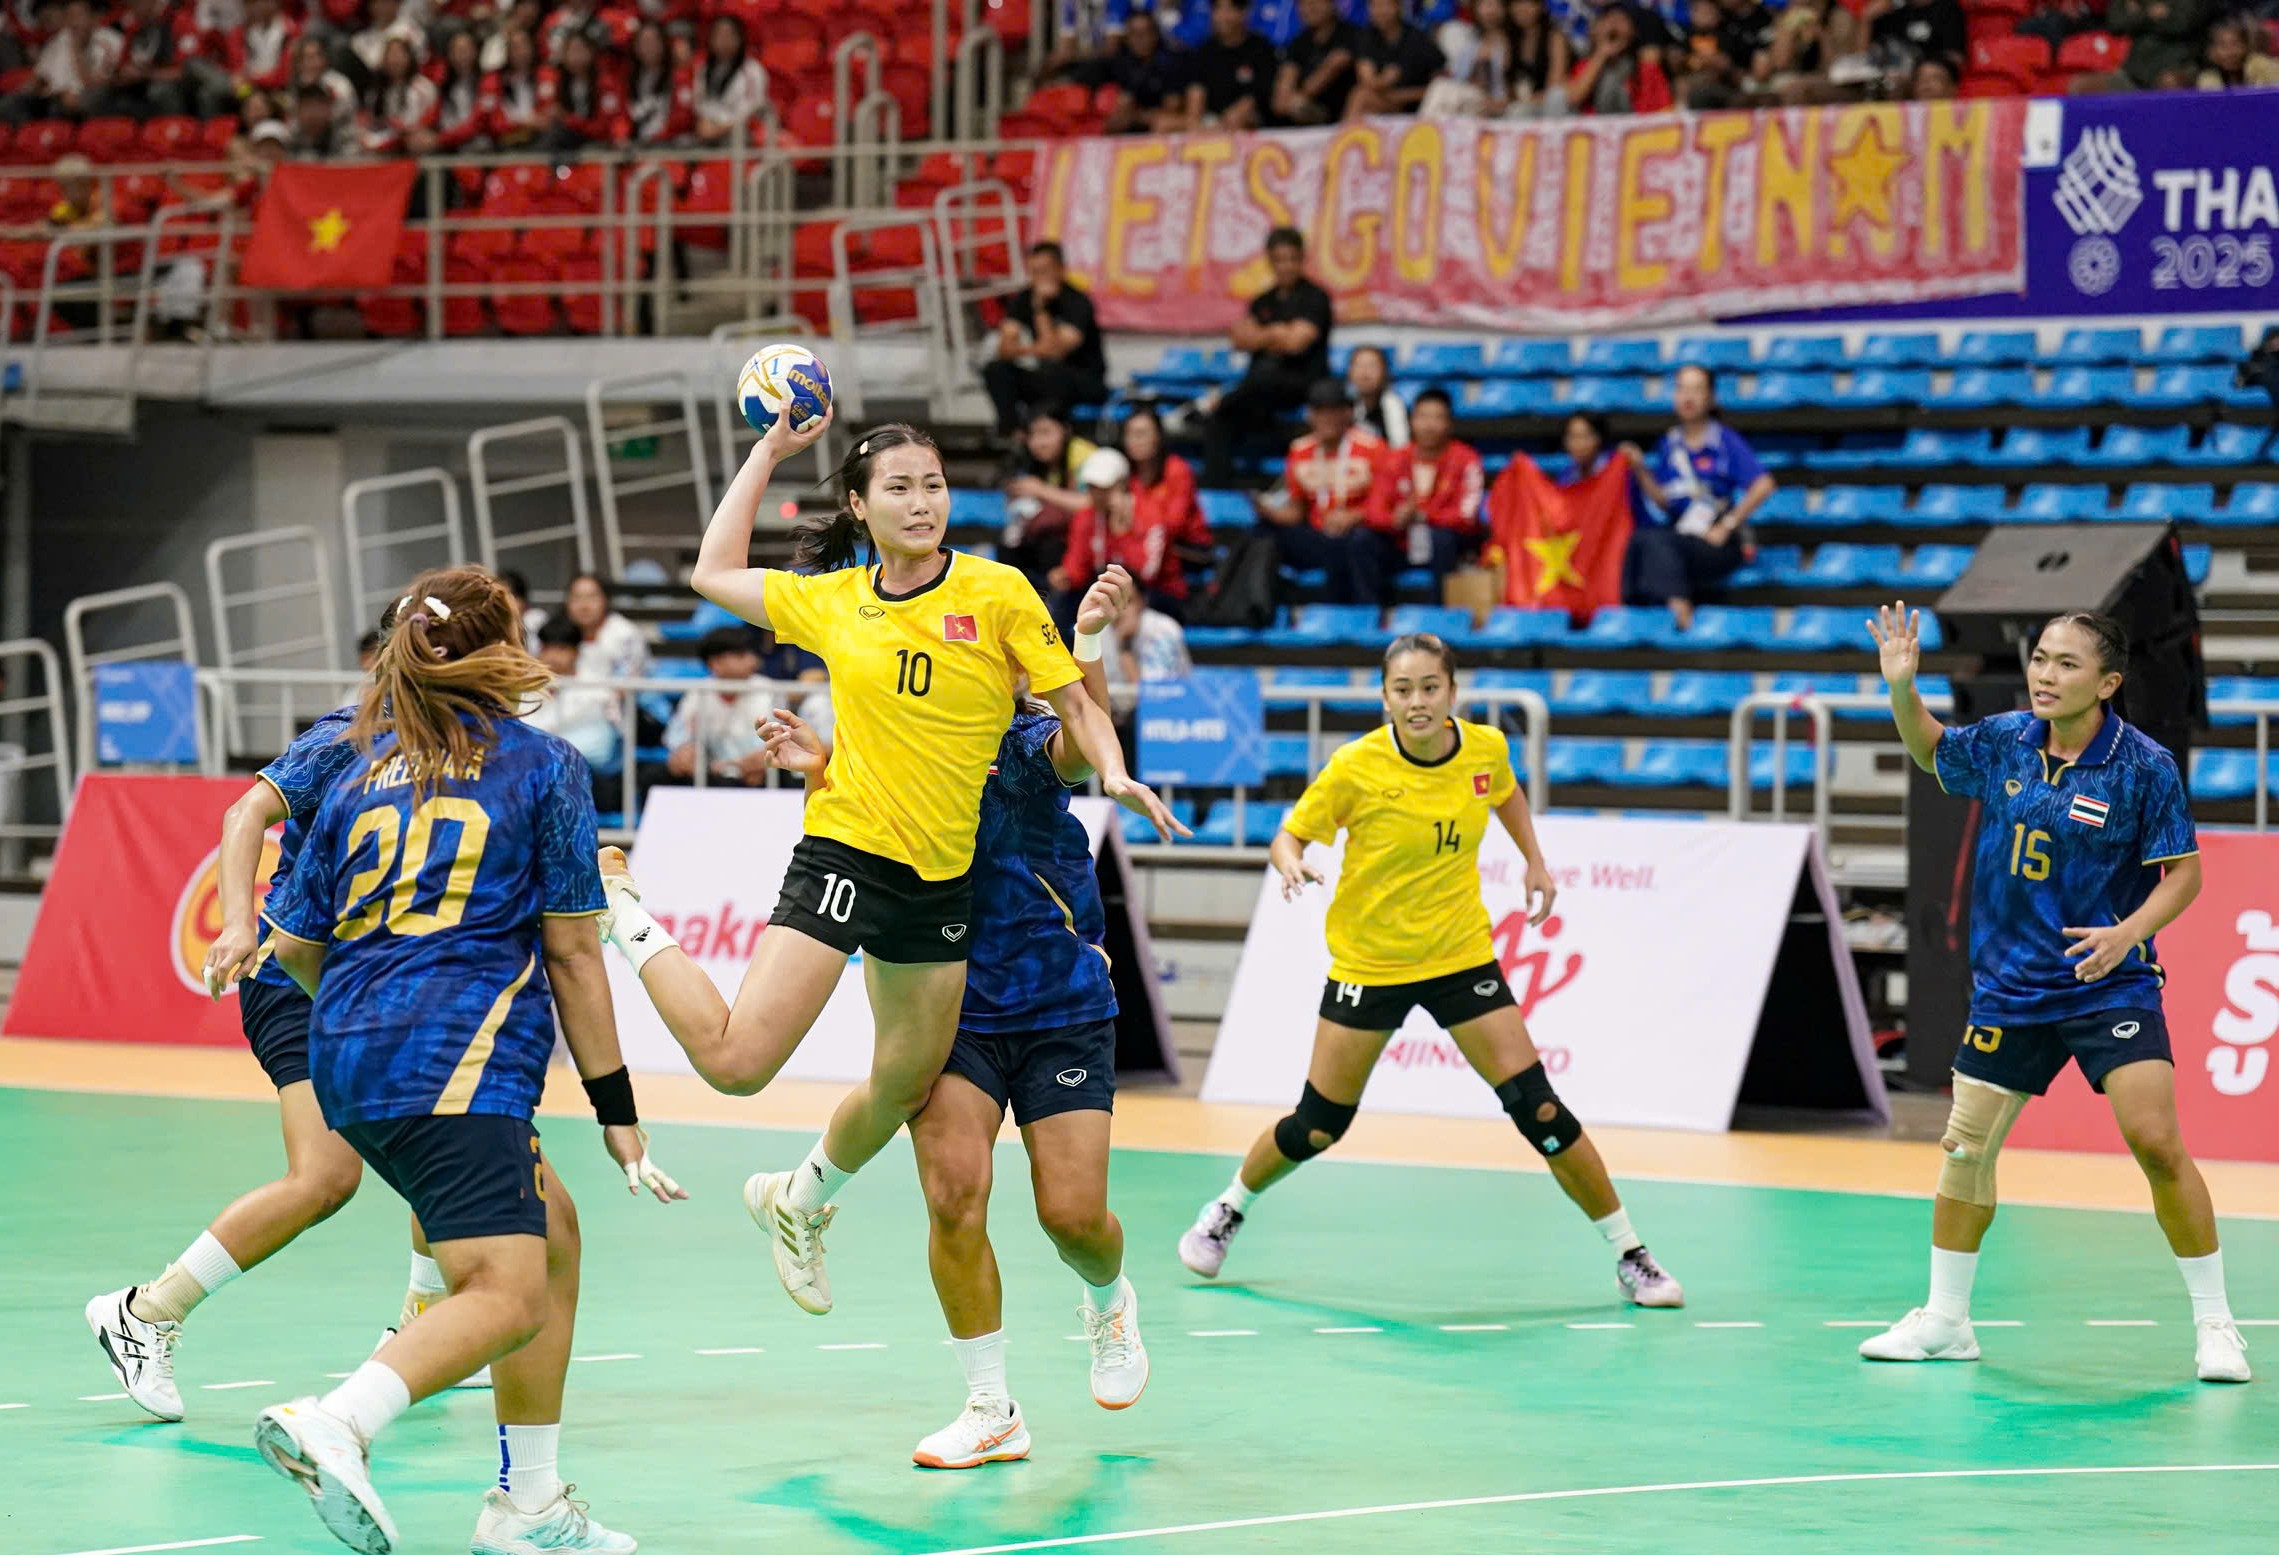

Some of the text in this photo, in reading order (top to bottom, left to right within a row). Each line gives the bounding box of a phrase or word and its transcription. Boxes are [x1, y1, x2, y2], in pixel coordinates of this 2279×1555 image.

[1316, 121, 1445, 289] GO
[2153, 165, 2279, 231] THA
[2150, 233, 2275, 290] 2025
[896, 649, 932, 697] 10
[1434, 820, 1461, 854] 14
[2010, 823, 2052, 881] 15
[333, 797, 491, 940] 20
[816, 873, 857, 923] 10
[1336, 982, 1363, 1008] 14
